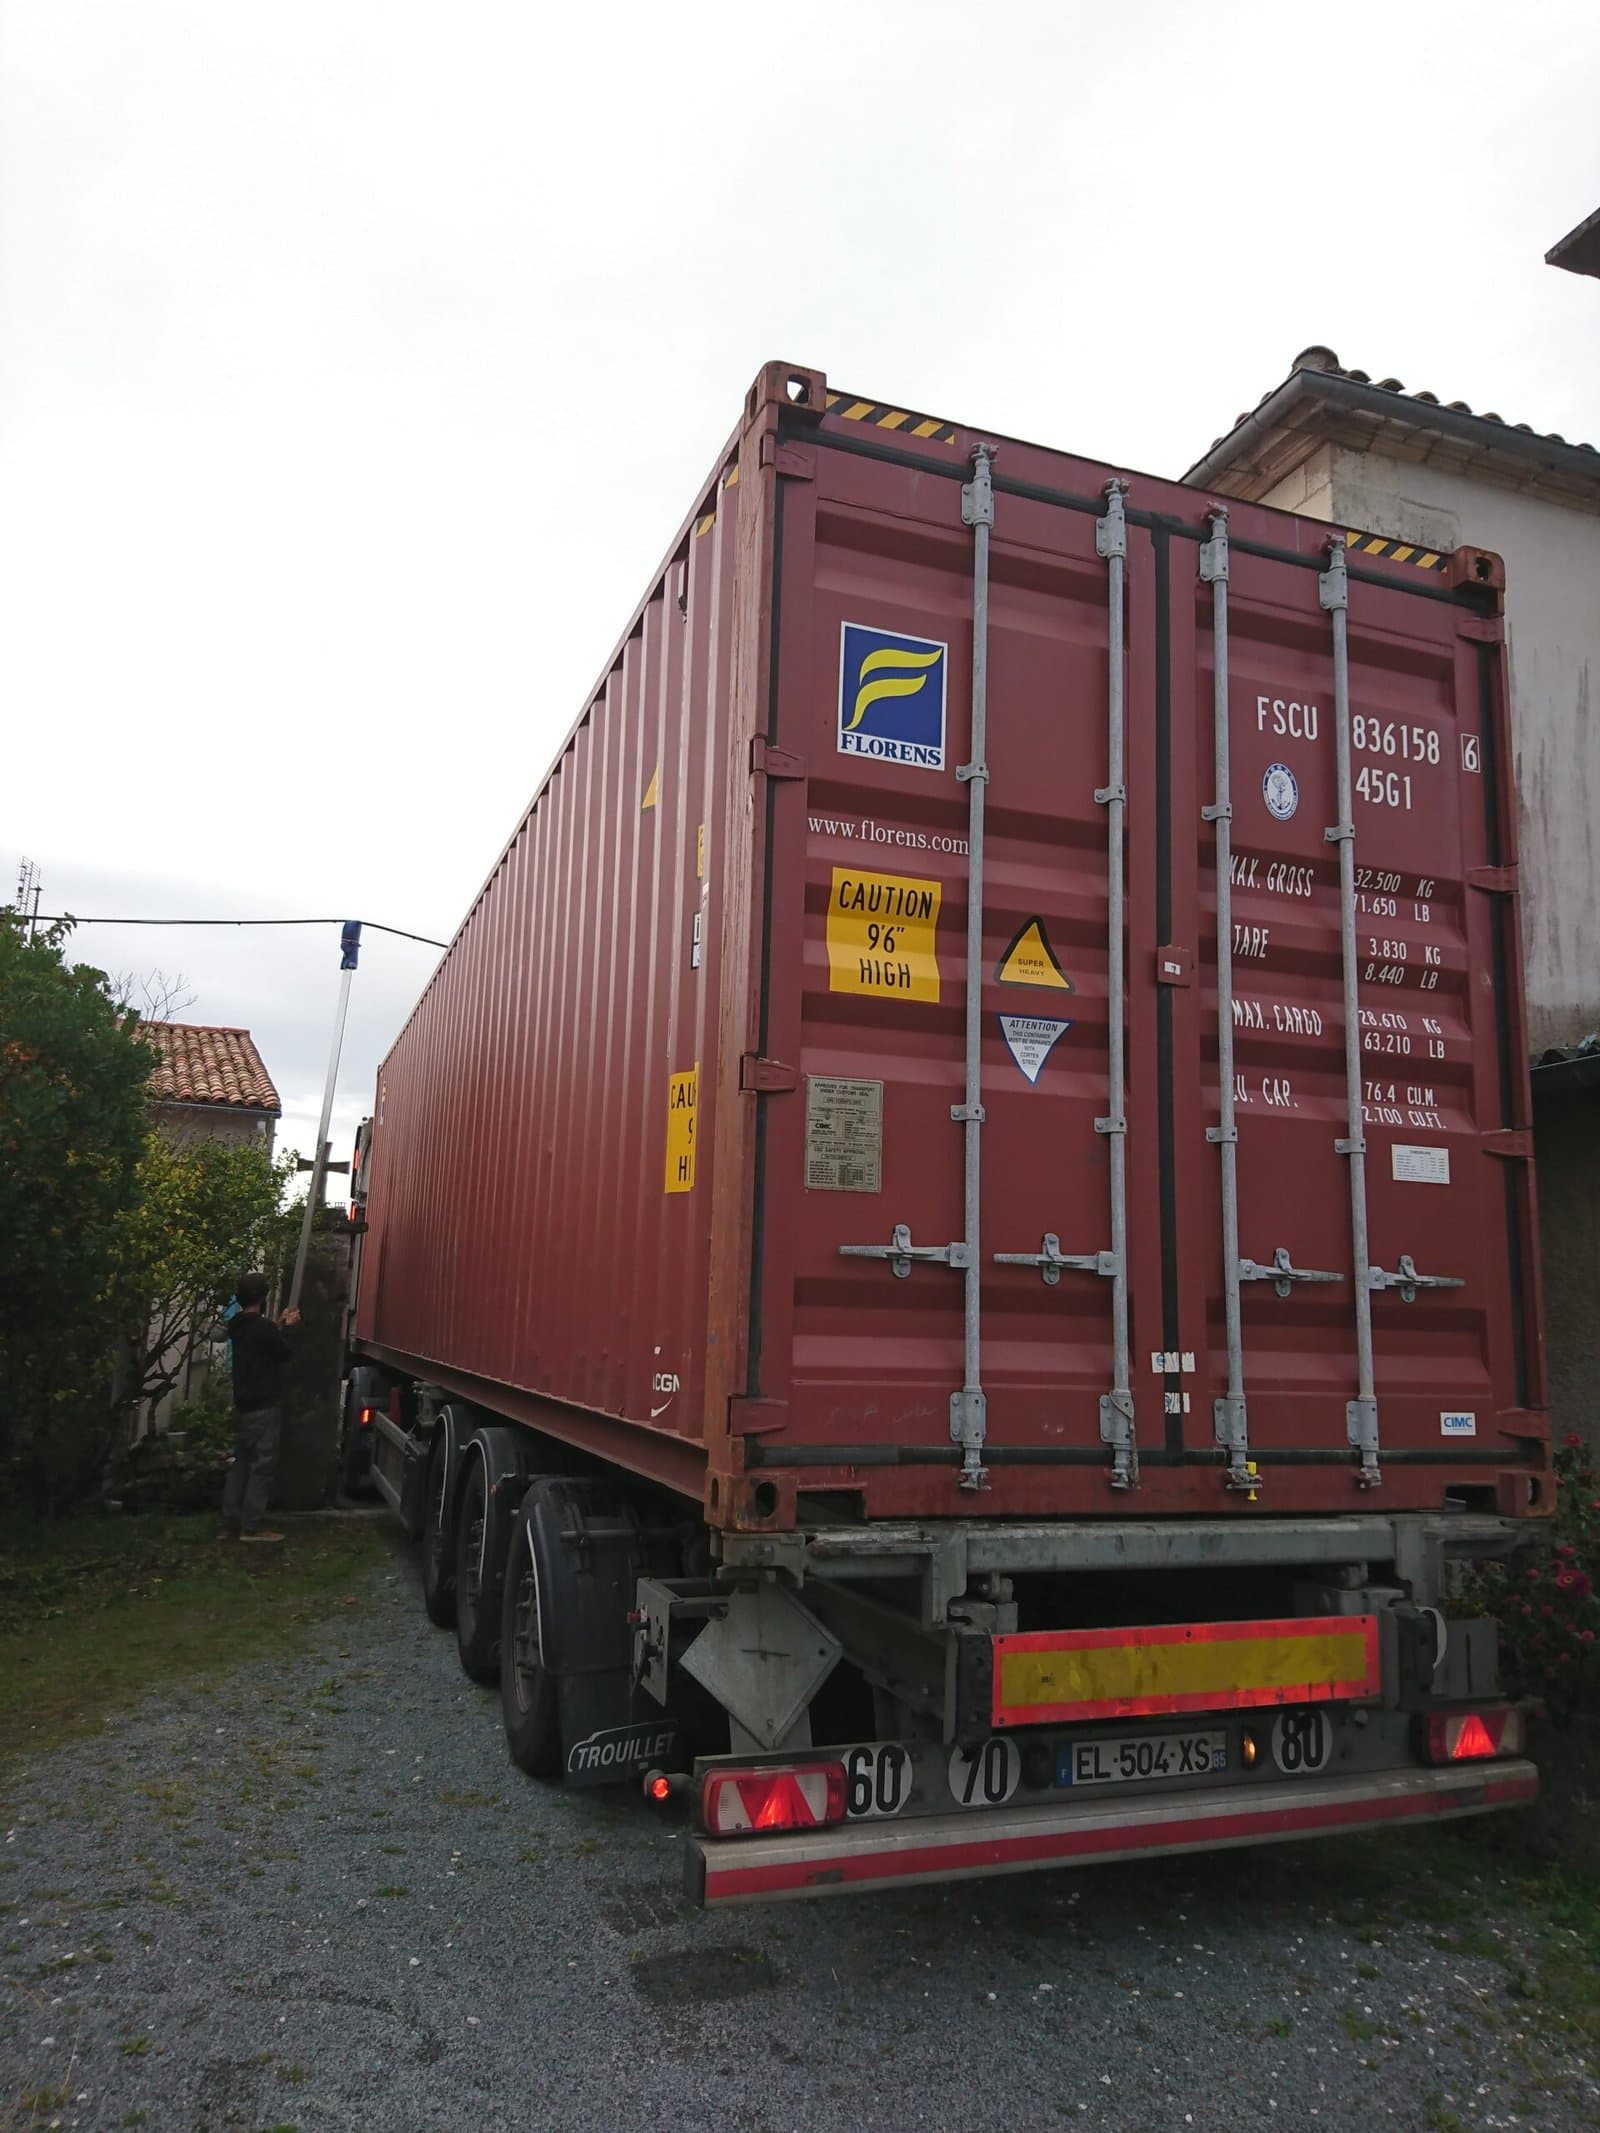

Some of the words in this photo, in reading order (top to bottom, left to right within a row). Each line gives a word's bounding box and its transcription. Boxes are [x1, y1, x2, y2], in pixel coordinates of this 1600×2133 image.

[841, 733, 941, 766] FLORENS
[1257, 696, 1318, 741] FSCU
[1353, 715, 1440, 765] 836158
[1465, 739, 1477, 770] 6
[1356, 767, 1411, 810] 45G1
[808, 817, 969, 855] www.florens.com
[1267, 862, 1314, 897] GROSS
[1417, 879, 1435, 898] KG
[839, 880, 933, 919] CAUTION
[1415, 904, 1430, 922] LB
[1233, 924, 1269, 958] TARE
[1425, 946, 1440, 965] KG
[860, 958, 911, 988] HIGH
[1017, 958, 1044, 968] SUPER
[1420, 970, 1438, 990] LB
[1010, 1020, 1058, 1032] ATTENTION
[1231, 1000, 1270, 1030] MAX.
[1274, 1005, 1321, 1036] CARGO
[1422, 1018, 1442, 1035] KG
[1429, 1040, 1444, 1058] LB
[1263, 1078, 1298, 1108] CAP.
[1365, 1082, 1396, 1102] 76.4
[1407, 1086, 1438, 1107] CU.M.
[1444, 1417, 1473, 1428] CIMC
[578, 1732, 676, 1770] TROUILLET
[1281, 1709, 1324, 1770] 80
[848, 1745, 902, 1815] 60
[961, 1739, 1009, 1803] 70
